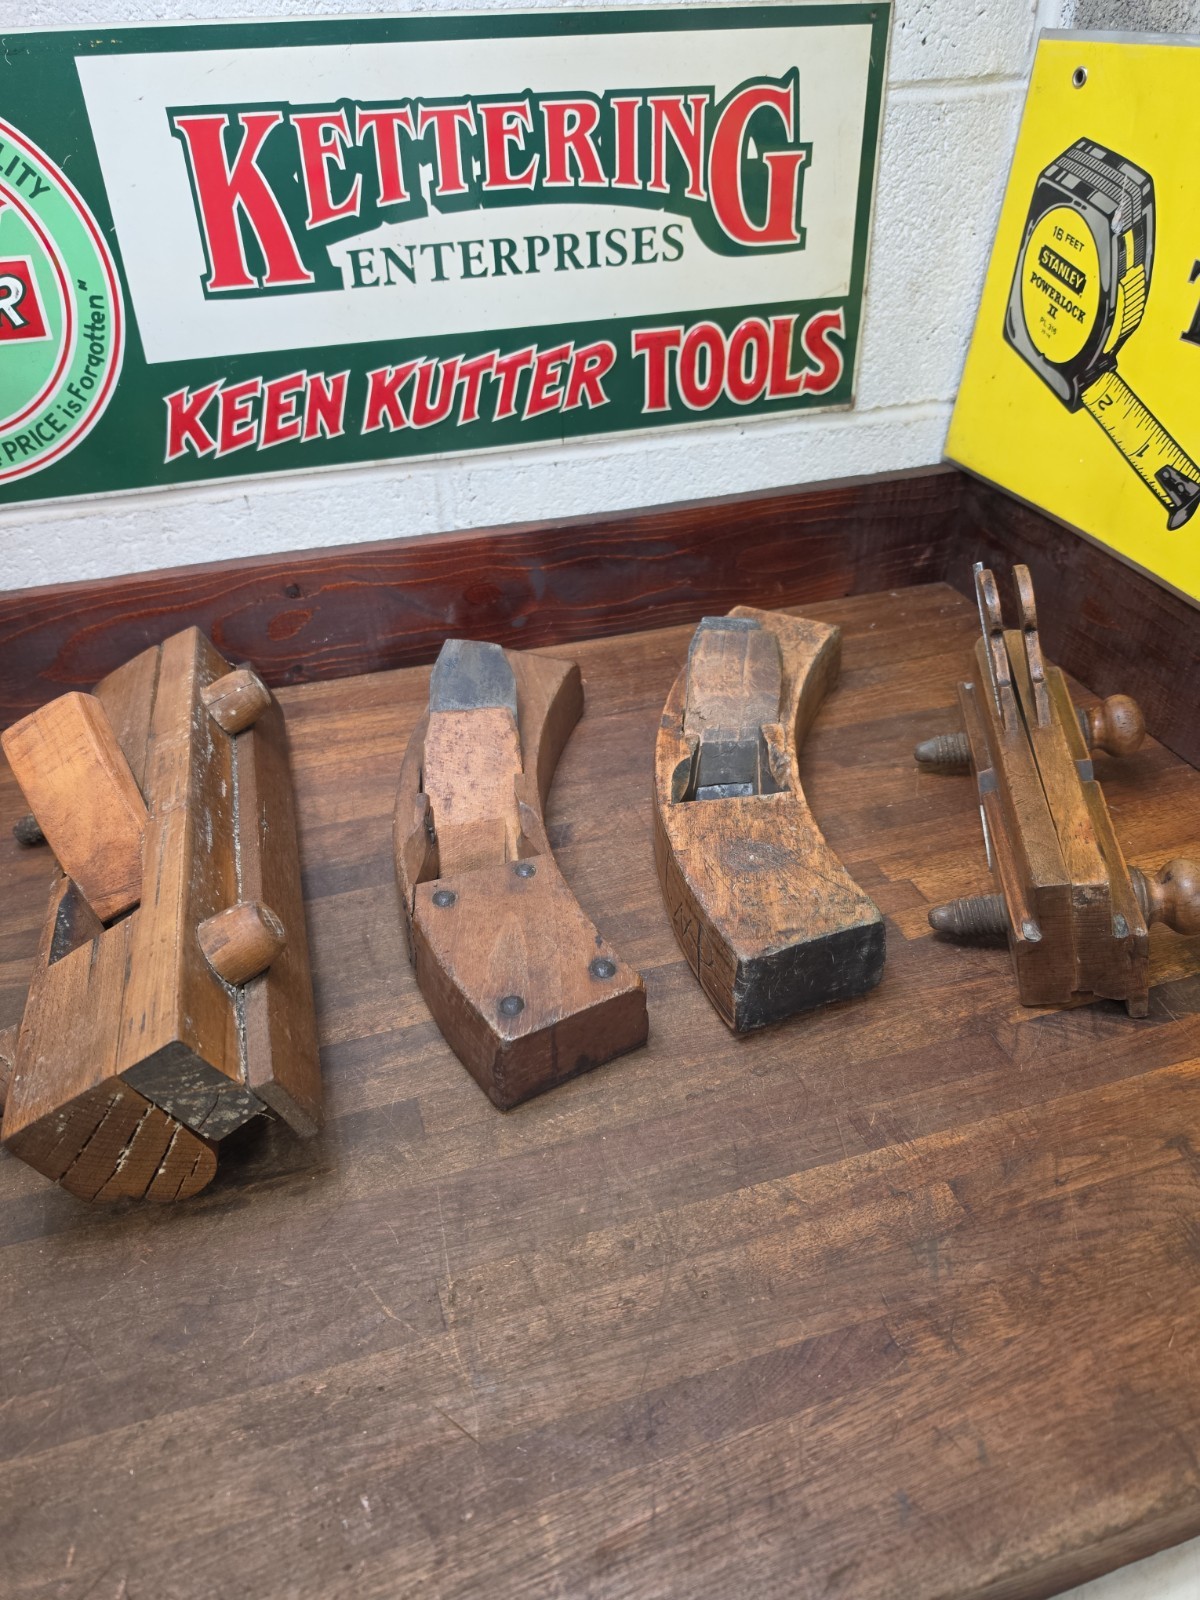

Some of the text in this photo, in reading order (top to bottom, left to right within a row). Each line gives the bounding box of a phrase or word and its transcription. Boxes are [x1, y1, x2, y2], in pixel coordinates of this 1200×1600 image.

[173, 79, 806, 293] KETTERING
[346, 223, 684, 289] ENTERPRISES
[1041, 249, 1084, 289] STANLEY
[1065, 233, 1085, 252] FEET
[1030, 271, 1086, 324] POWERLOCK
[163, 306, 846, 464] KEEN KUTTER TOOLS
[2, 413, 67, 462] PRICE
[57, 398, 83, 419] is
